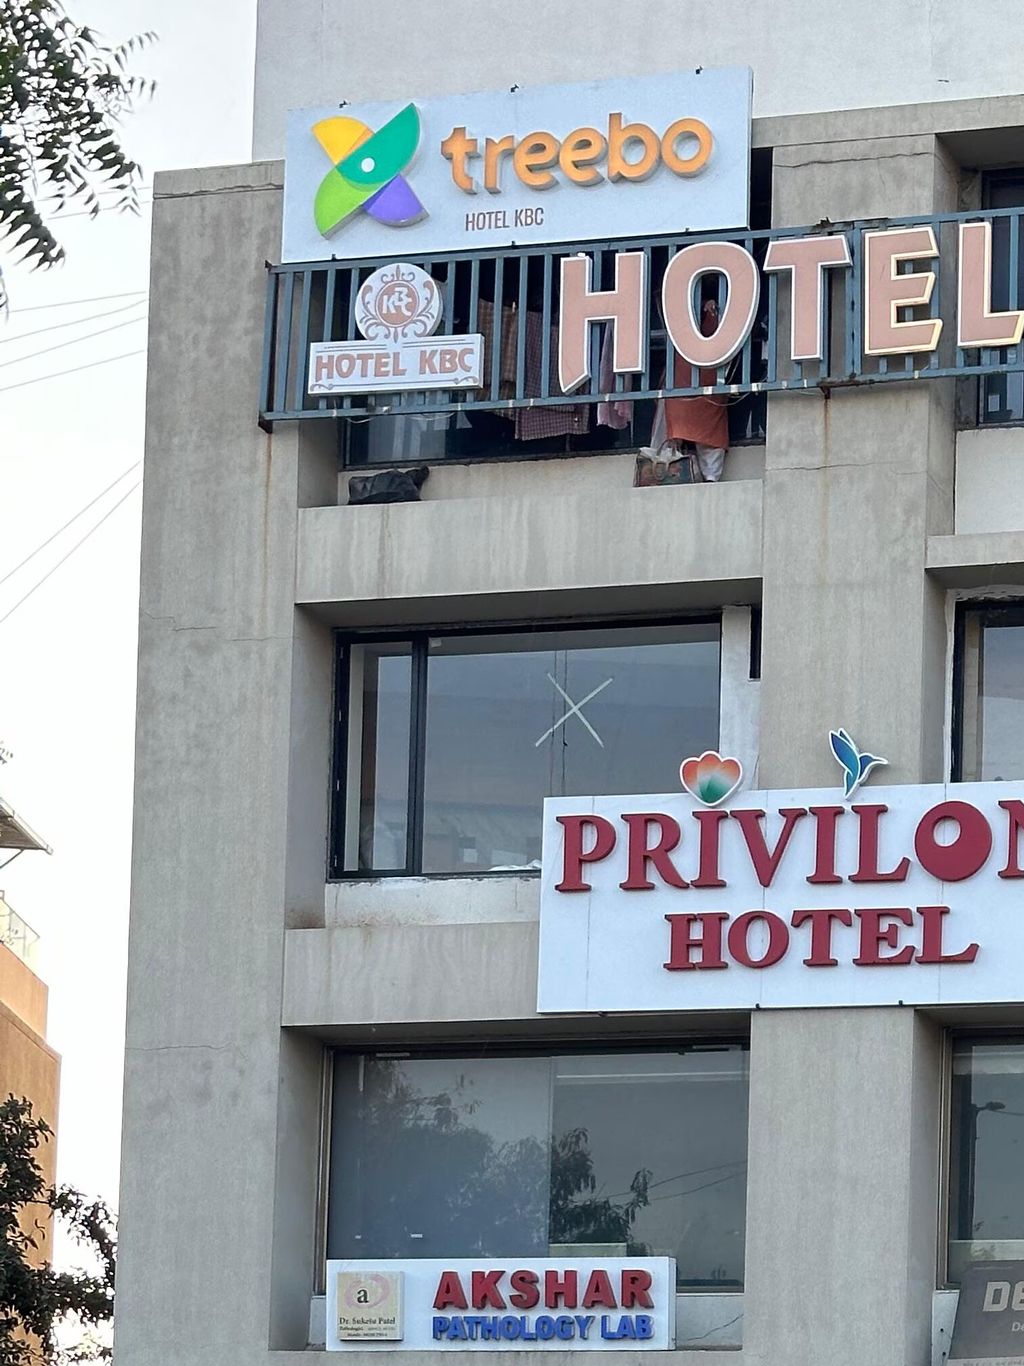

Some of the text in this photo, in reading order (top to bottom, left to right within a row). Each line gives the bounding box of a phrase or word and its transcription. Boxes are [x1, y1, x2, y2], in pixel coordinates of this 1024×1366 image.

[440, 112, 715, 194] treebo
[464, 207, 544, 231] HOTEL KBC
[315, 347, 474, 382] HOTEL KBC
[663, 905, 980, 970] HOTEL
[432, 1269, 655, 1310] AKSHAR
[432, 1314, 656, 1342] PATHOLOGY LAB
